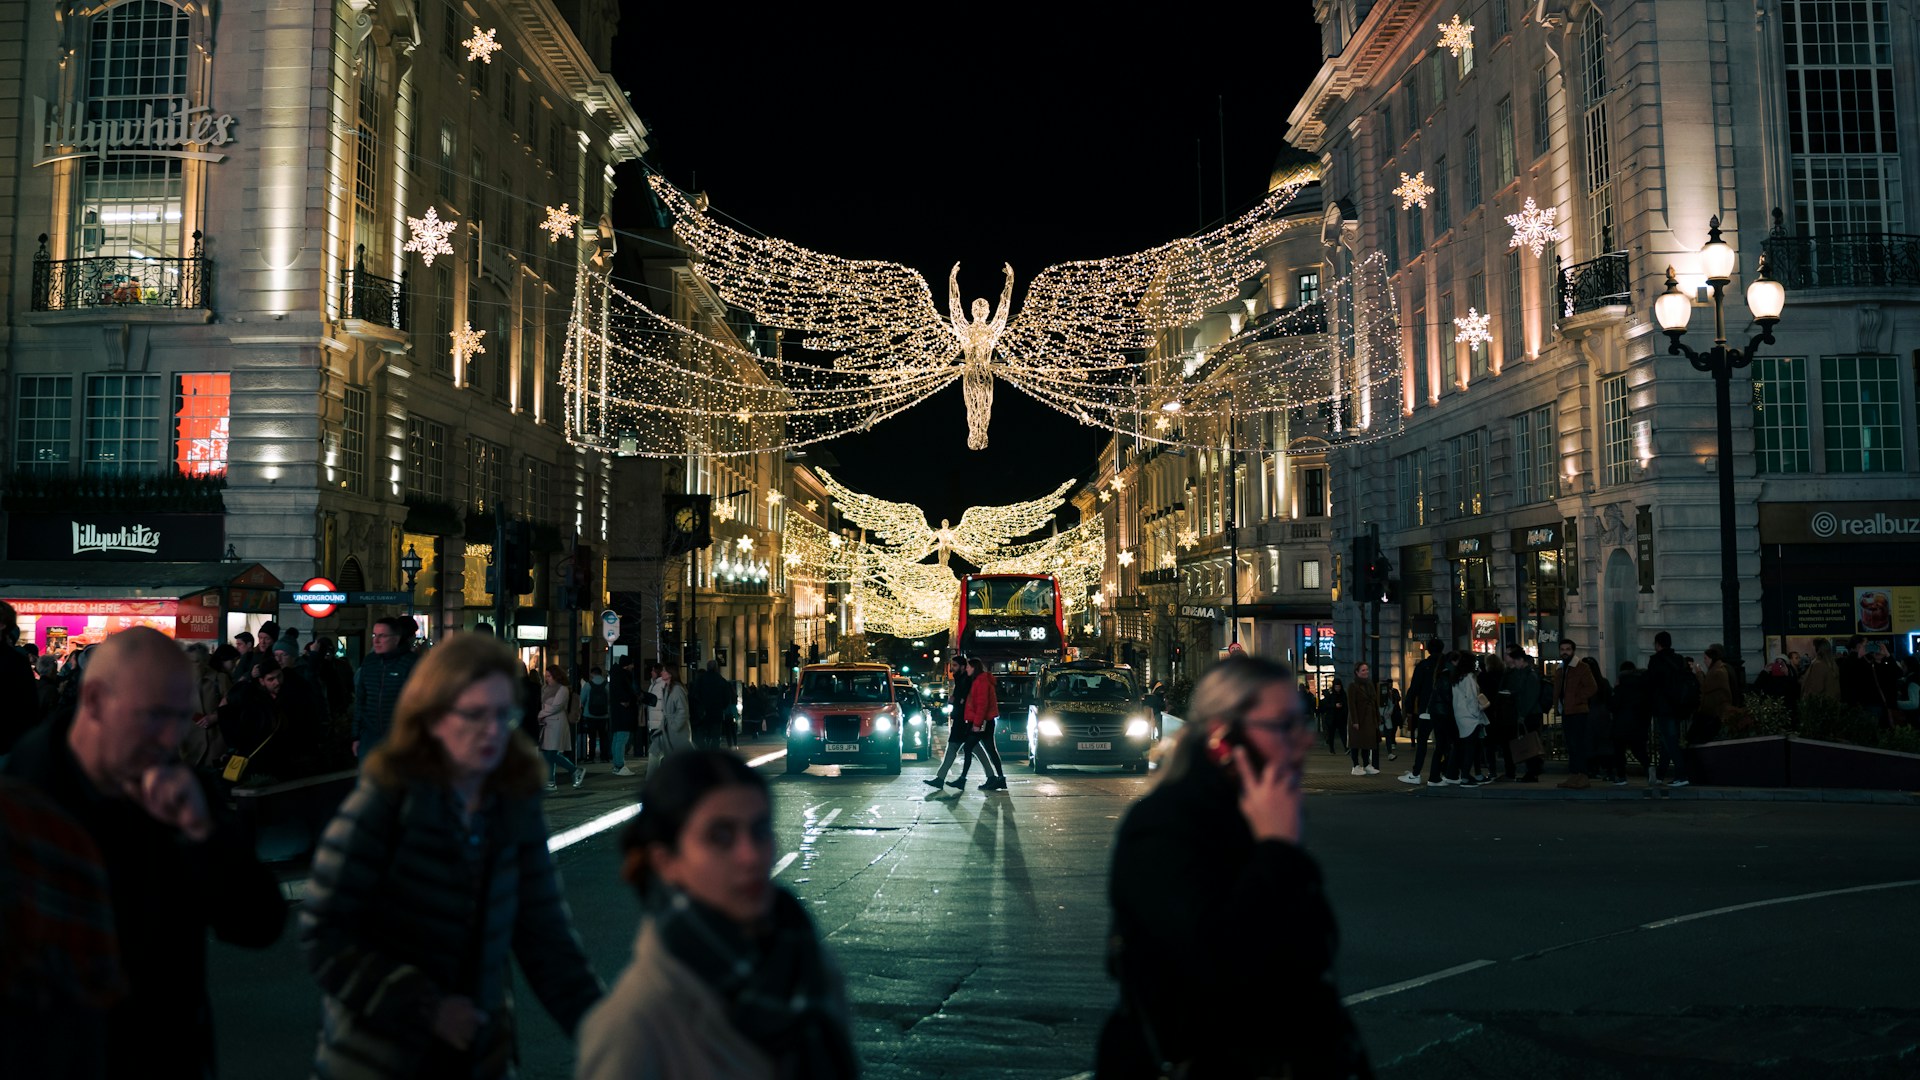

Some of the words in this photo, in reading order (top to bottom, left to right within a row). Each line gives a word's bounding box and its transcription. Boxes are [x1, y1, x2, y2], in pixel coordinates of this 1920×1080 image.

[33, 95, 232, 168] Lillywhites
[72, 521, 160, 554] Lillywhites
[293, 594, 346, 602] UNDERGROUND
[38, 603, 87, 613] TICKETS
[89, 603, 121, 613] HERE
[1182, 605, 1216, 618] CINEMA
[190, 624, 210, 633] TRAVEL
[1475, 619, 1496, 627] Pizza
[1030, 627, 1046, 640] 88
